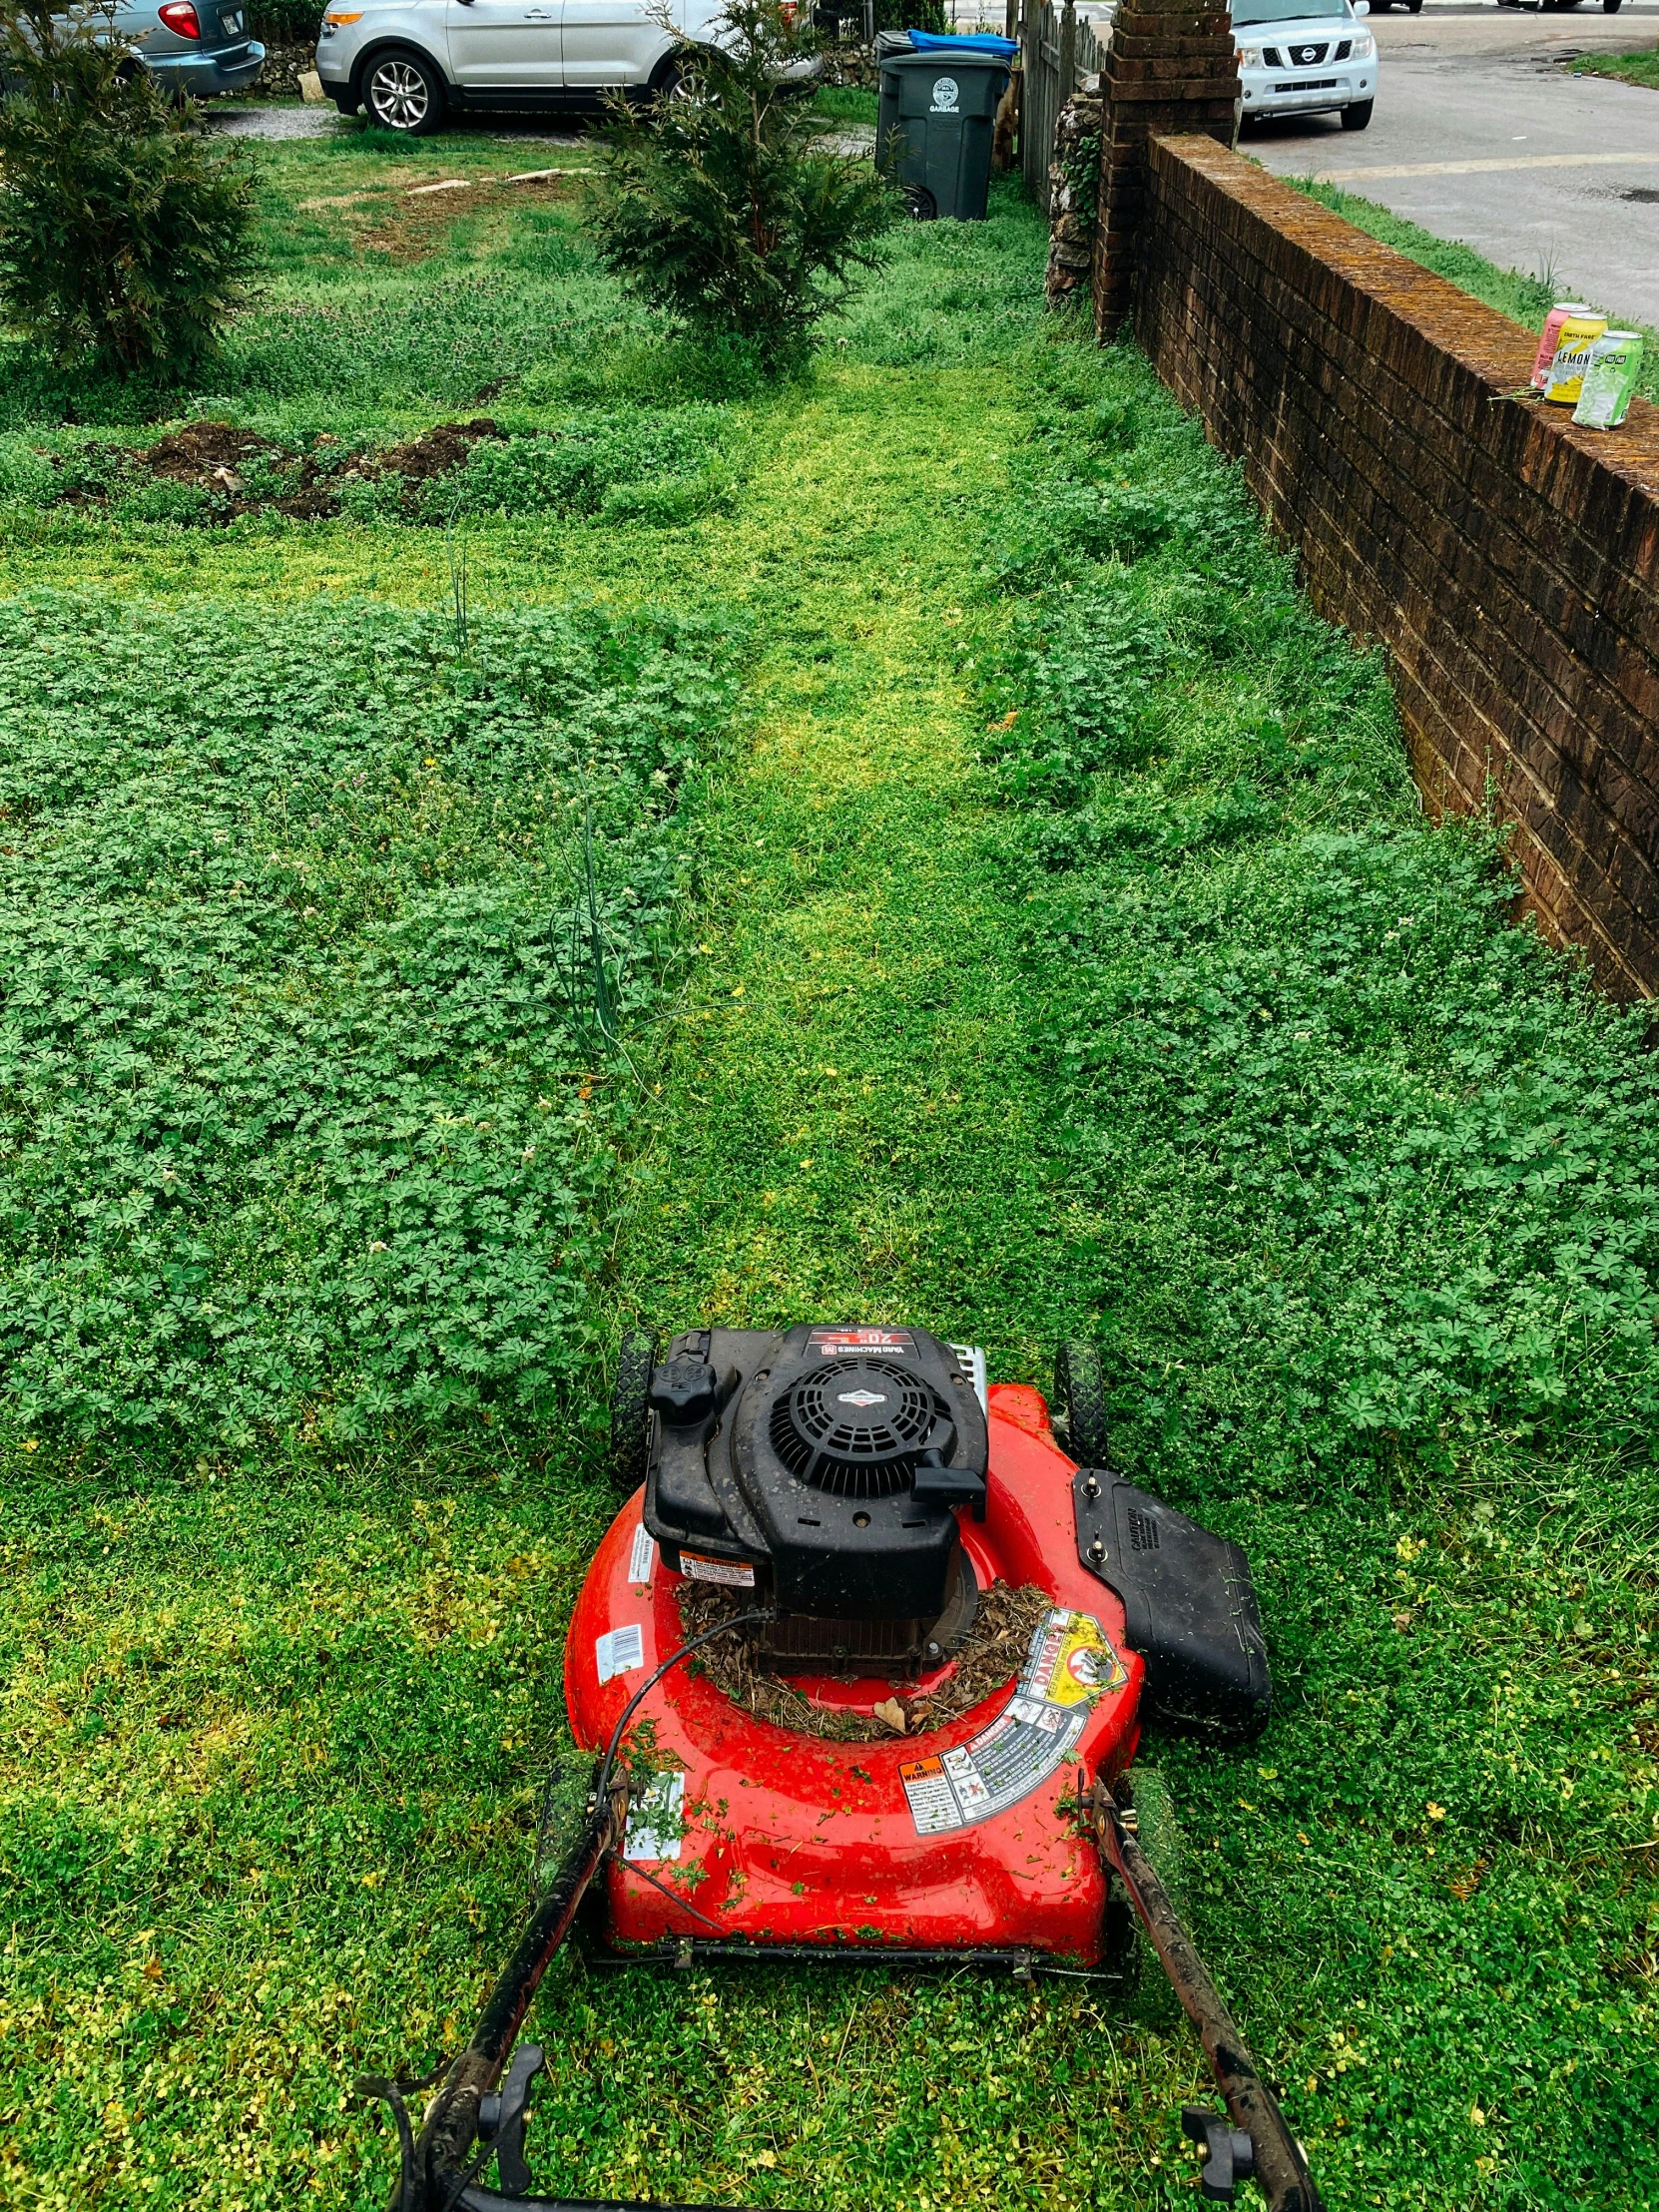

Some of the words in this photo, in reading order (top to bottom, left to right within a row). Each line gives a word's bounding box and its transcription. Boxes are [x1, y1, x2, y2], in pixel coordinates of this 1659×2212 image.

[1557, 351, 1590, 364] LEMON
[1128, 1508, 1141, 1550] CAUTION
[704, 1557, 741, 1568] WARNING
[1034, 1622, 1066, 1686] DANGER
[1054, 1661, 1065, 1682] HANDS
[977, 1718, 1008, 1745] DANGER
[903, 1767, 942, 1781] WARNING
